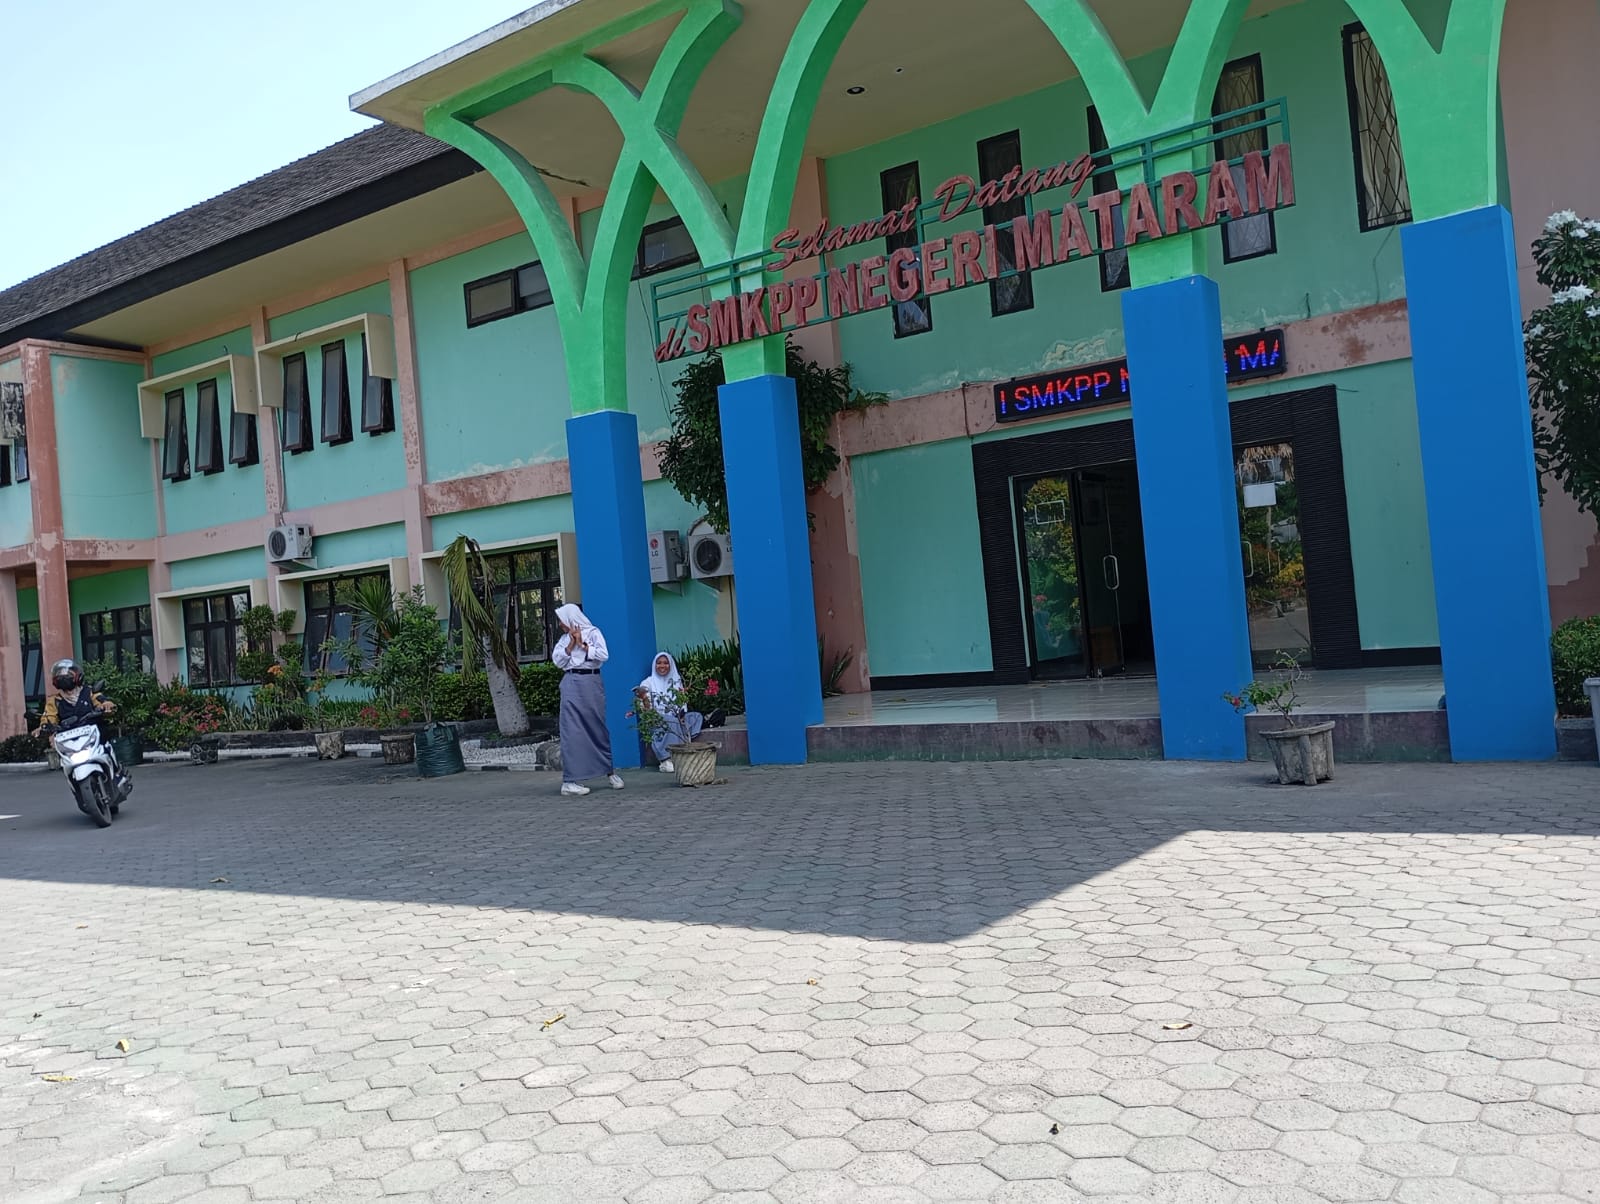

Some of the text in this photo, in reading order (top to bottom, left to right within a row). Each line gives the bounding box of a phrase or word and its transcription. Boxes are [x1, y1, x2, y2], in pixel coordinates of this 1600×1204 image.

[654, 143, 1296, 363] di SMKPP NEGERI MATARAM
[766, 153, 1097, 272] Selamat Datang
[1014, 371, 1111, 411] SMKPP
